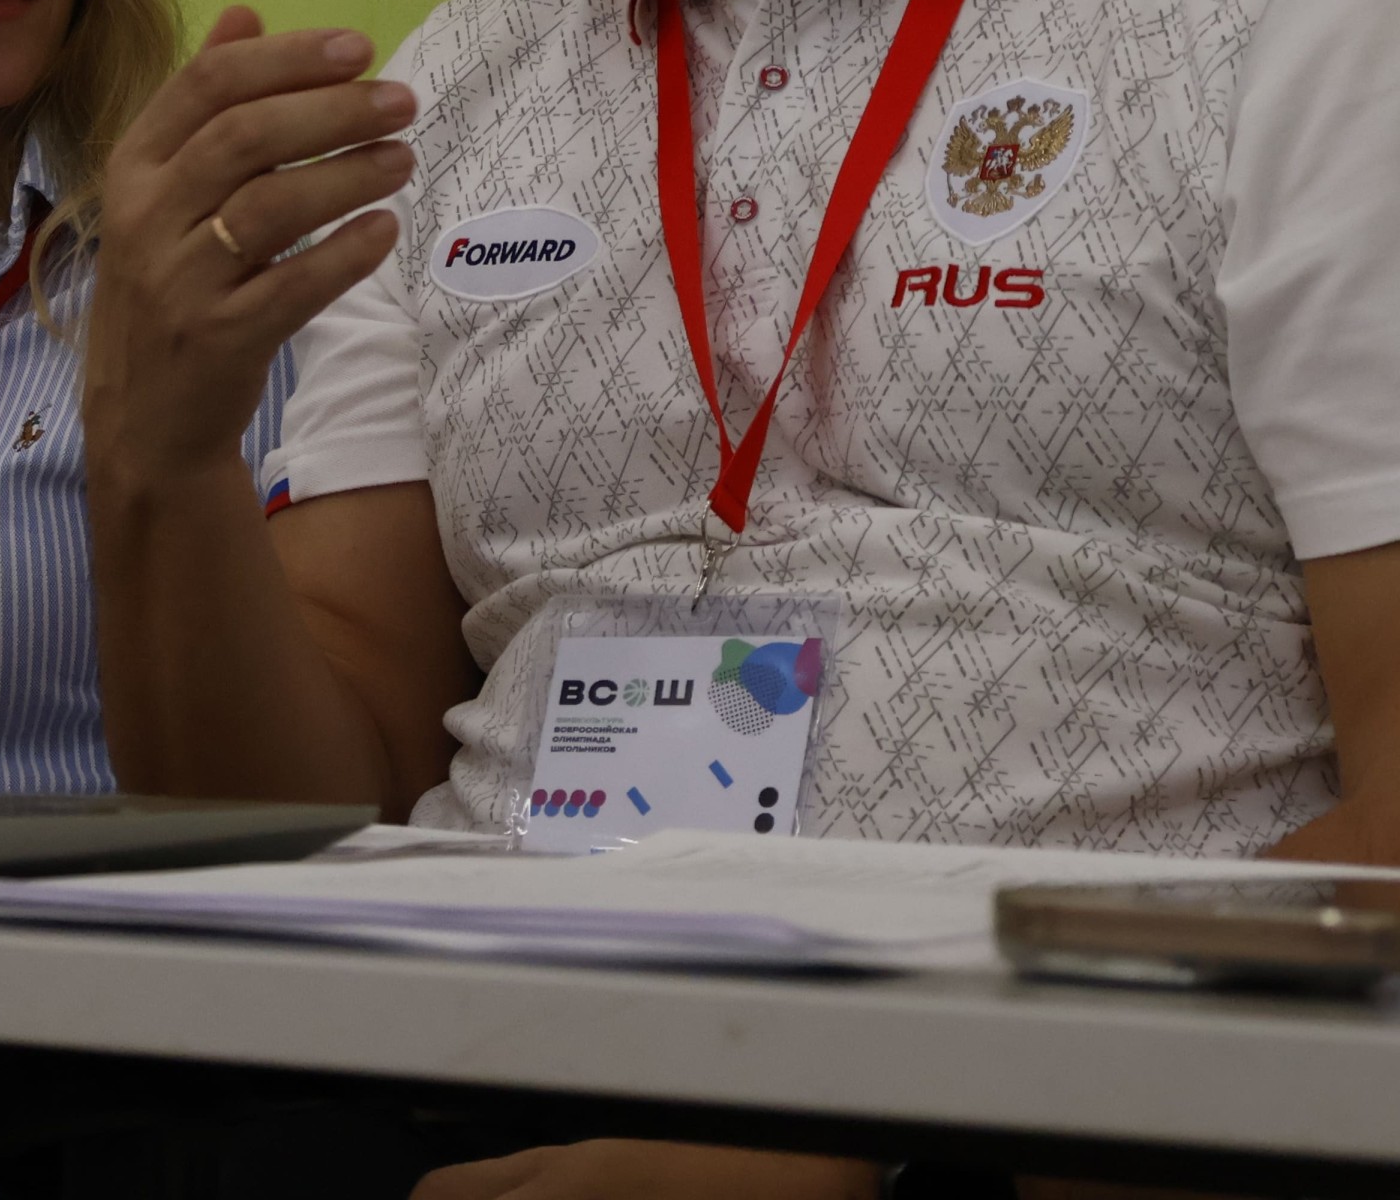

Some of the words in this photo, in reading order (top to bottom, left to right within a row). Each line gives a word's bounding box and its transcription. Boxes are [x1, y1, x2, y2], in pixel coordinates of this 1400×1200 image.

[445, 238, 576, 267] FORWARD
[891, 264, 1045, 309] RUS
[554, 725, 638, 734] ВСЕРОССИЙСКАЯ
[550, 745, 616, 753] ШКОЛЬНИКОВ
